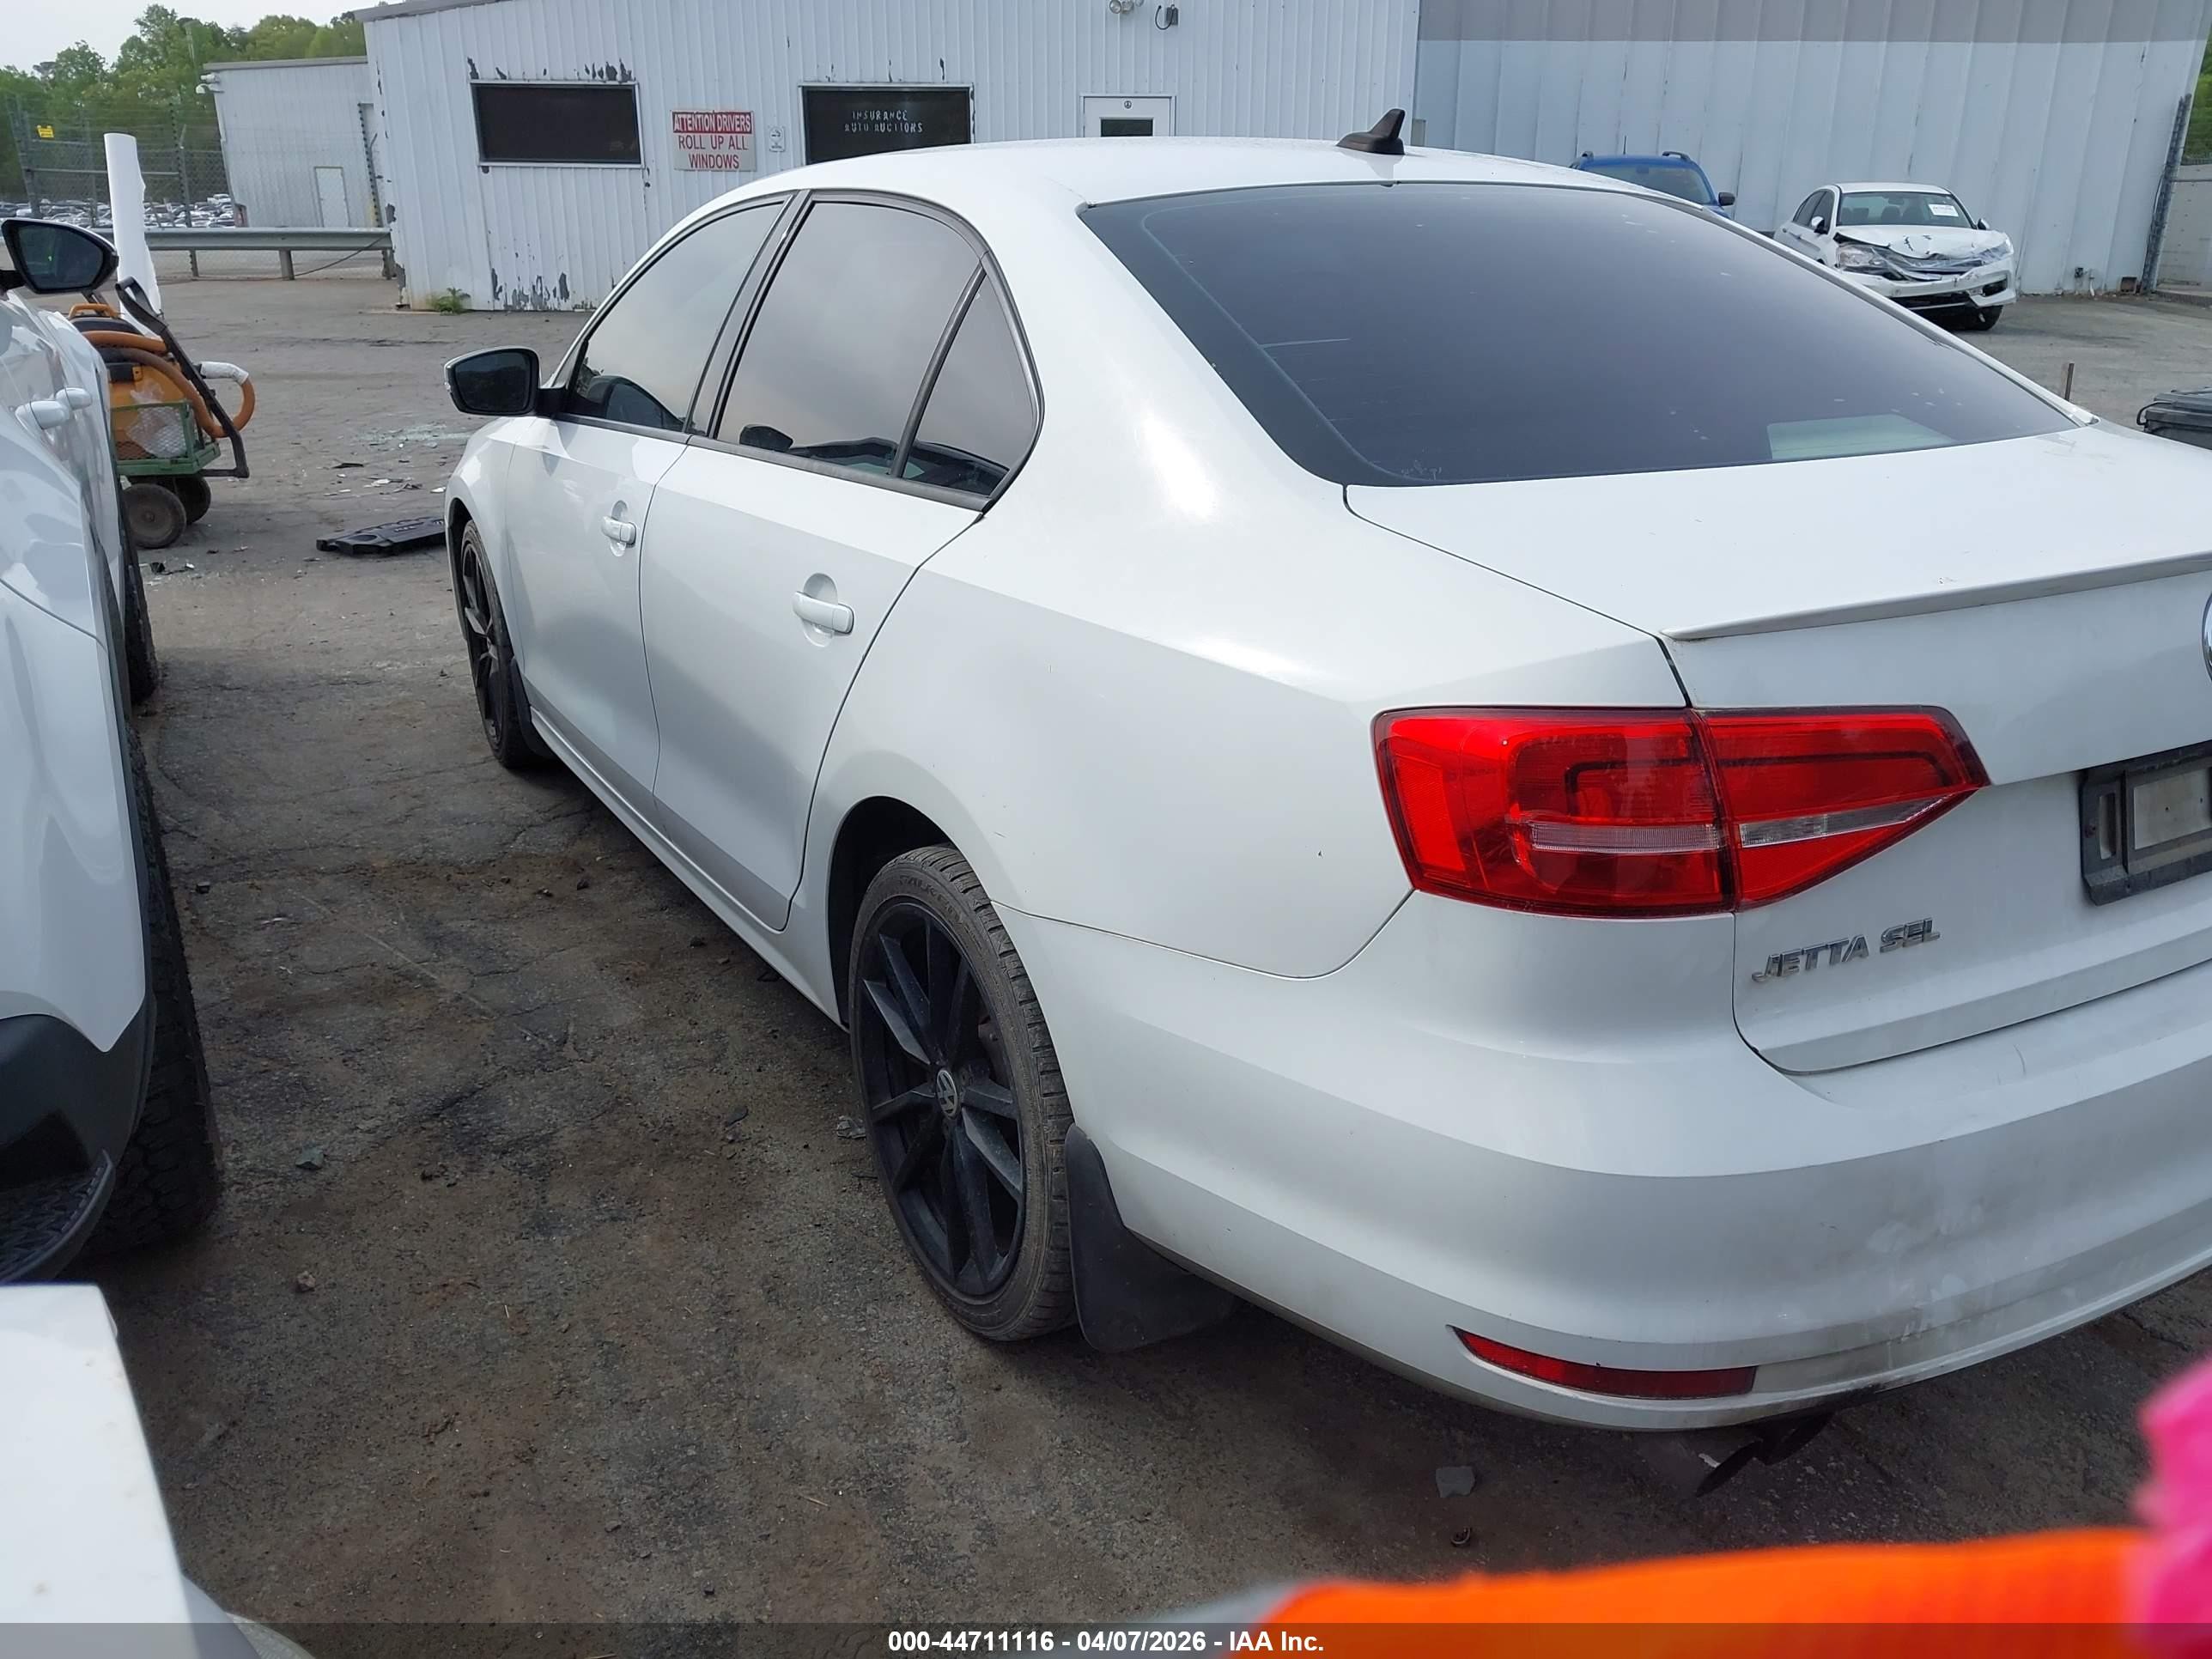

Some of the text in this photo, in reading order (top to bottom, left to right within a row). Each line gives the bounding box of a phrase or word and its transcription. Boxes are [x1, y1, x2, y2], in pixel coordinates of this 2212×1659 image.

[852, 109, 908, 120] INSURANCE
[674, 113, 750, 132] ATTENTION DRIVERS
[845, 122, 923, 133] AUTO AUCTIONS
[679, 135, 749, 150] ROLL UP ALL
[689, 154, 739, 169] WINDOWS
[1751, 917, 1941, 982] JETTA SEL
